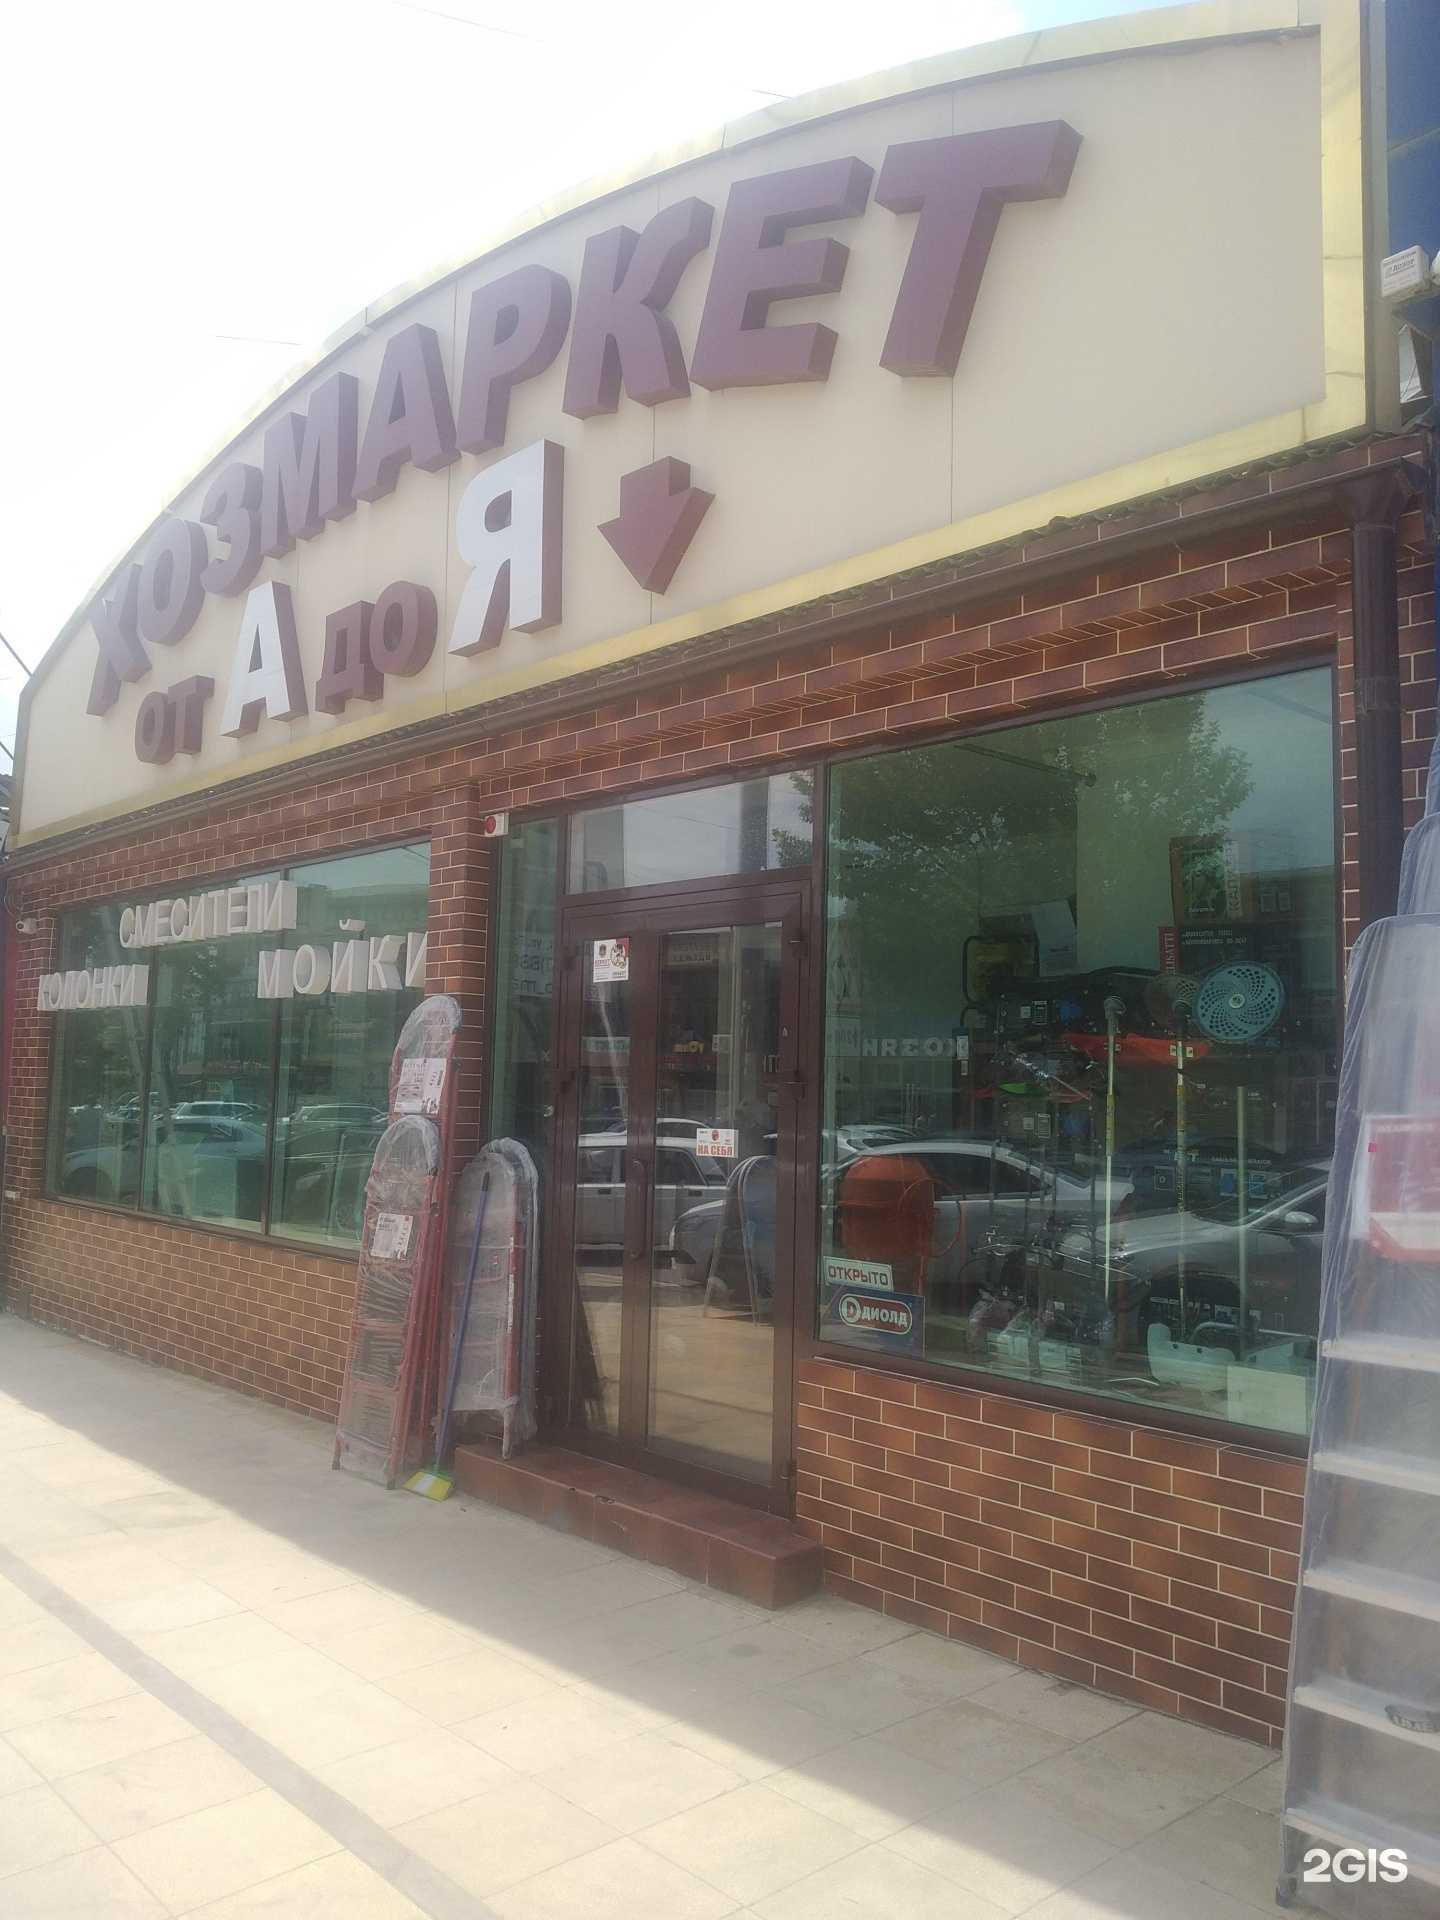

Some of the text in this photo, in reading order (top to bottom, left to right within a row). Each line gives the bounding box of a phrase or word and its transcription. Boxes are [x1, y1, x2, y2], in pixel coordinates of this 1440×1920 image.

[87, 119, 1084, 716] ХОЗМАРКЕТ
[134, 439, 564, 765] ОТ А ДО Я
[119, 880, 297, 948] СМЕСИТЕЛИ
[37, 964, 149, 1011] КОЛОНКИ
[257, 919, 427, 998] МОЙКИ
[828, 1265, 889, 1286] ОТКРЫТО
